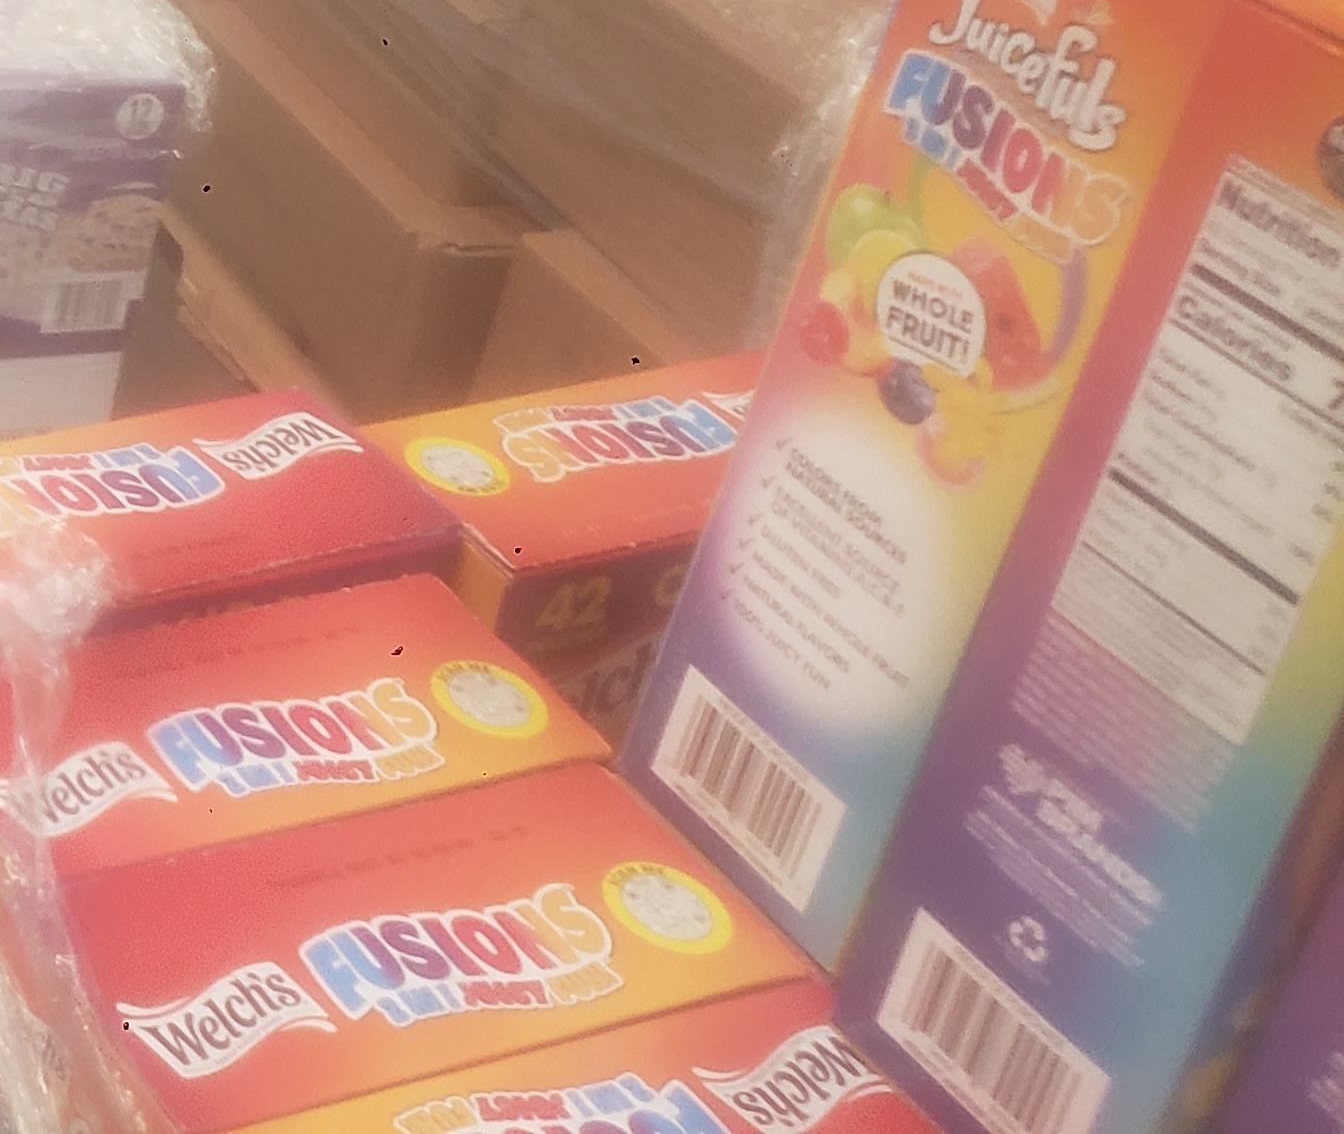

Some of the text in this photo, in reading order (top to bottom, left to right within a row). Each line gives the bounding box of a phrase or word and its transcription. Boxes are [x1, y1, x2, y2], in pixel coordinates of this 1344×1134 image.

[130, 97, 154, 124] 12
[884, 48, 1134, 248] FUSIONS
[885, 304, 971, 367] FRUIT!
[891, 279, 973, 335] WHOLE
[222, 411, 346, 474] Welch's
[502, 398, 739, 482] FUSIONS
[148, 676, 439, 792] FUSIONS
[299, 882, 616, 1020] FUSIONS
[145, 969, 303, 1072] Welch's
[734, 1034, 867, 1132] Welch's
